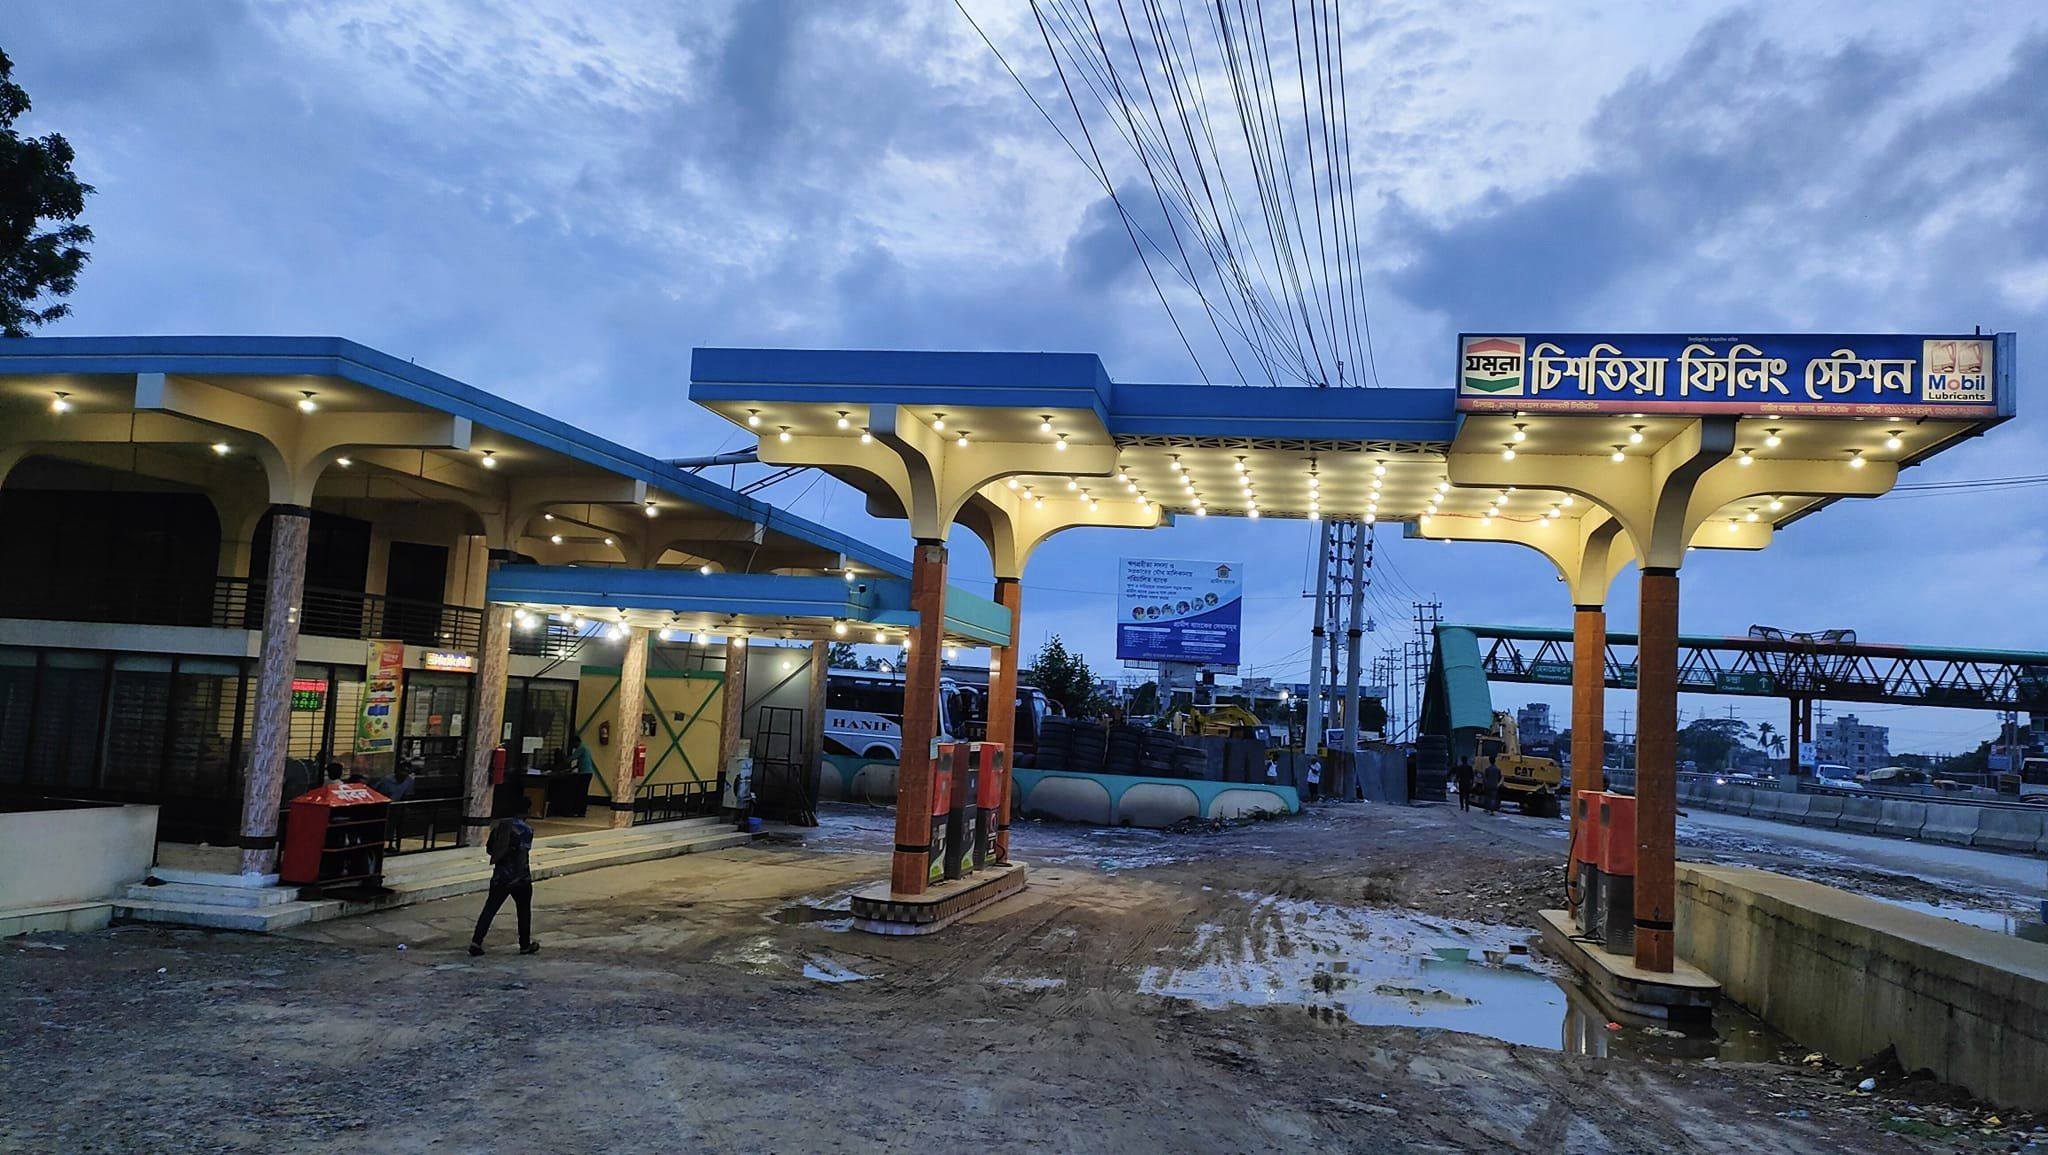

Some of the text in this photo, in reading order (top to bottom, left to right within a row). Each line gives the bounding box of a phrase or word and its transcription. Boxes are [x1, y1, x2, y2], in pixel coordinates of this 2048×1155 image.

[1466, 356, 1520, 376] যমুনা
[1528, 343, 1917, 400] চিশতিয়া ফিলিং স্টেশন
[1929, 374, 1985, 391] Mobil
[1929, 391, 1986, 401] Lubricants
[833, 718, 892, 732] HANIF
[1514, 766, 1536, 777] CAT
